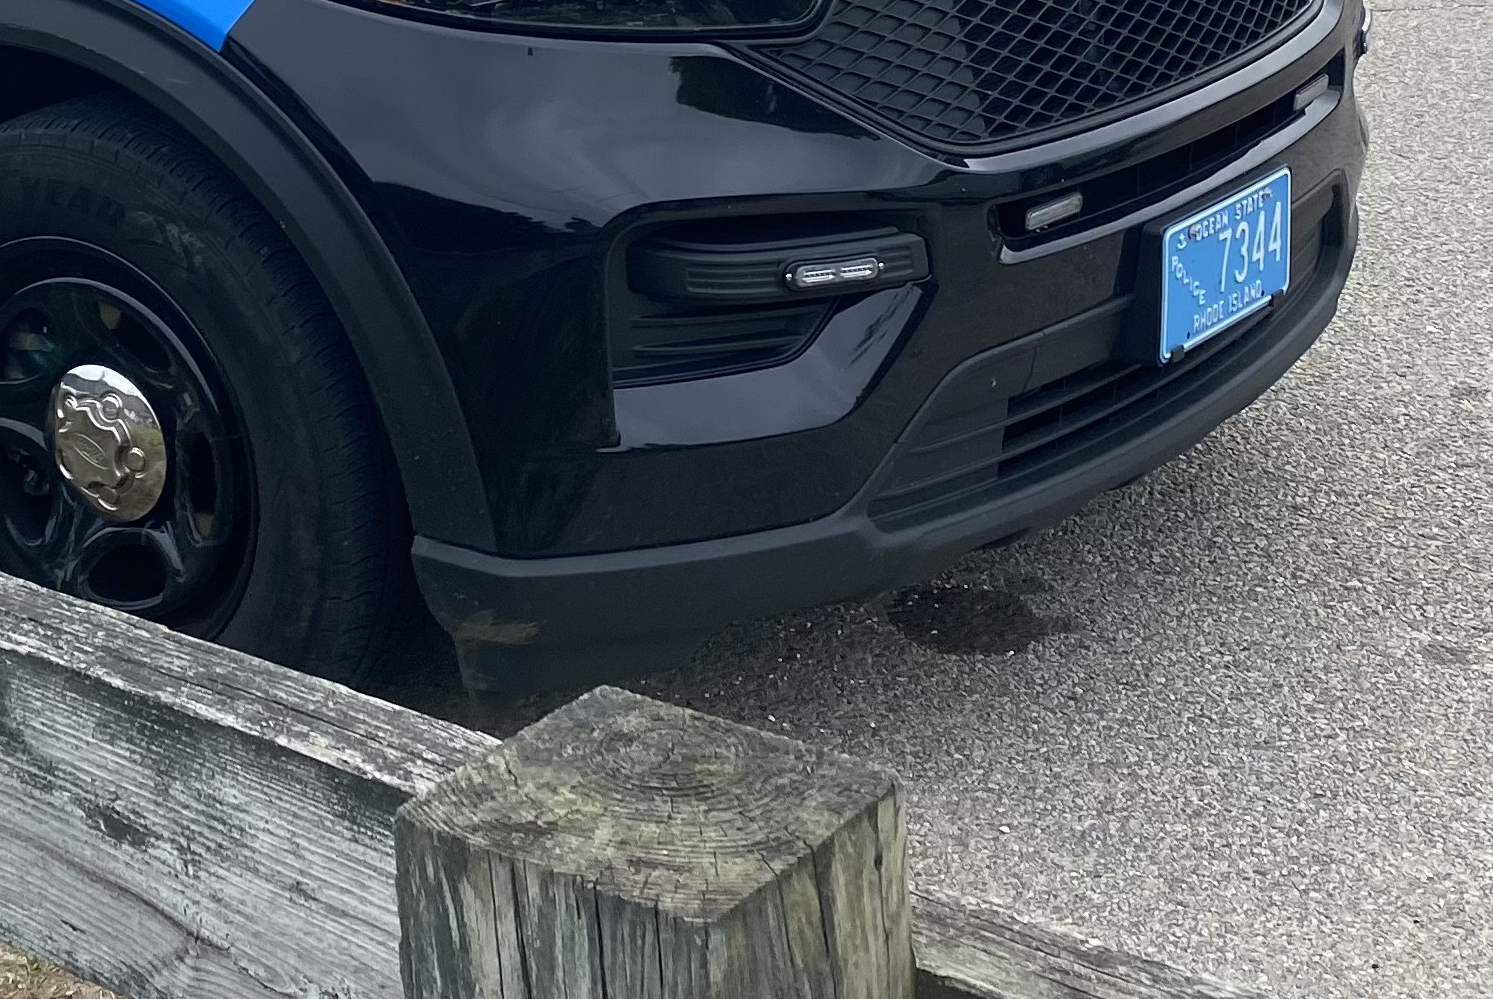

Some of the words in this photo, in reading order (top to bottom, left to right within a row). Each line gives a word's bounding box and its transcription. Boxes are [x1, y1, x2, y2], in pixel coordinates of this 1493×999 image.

[1194, 210, 1229, 242] OCEAN
[1234, 193, 1265, 220] STATE
[1218, 201, 1283, 294] 7344
[1171, 255, 1207, 306] POLICE
[1192, 300, 1225, 333] RHODE
[1228, 279, 1263, 313] ISLAND
